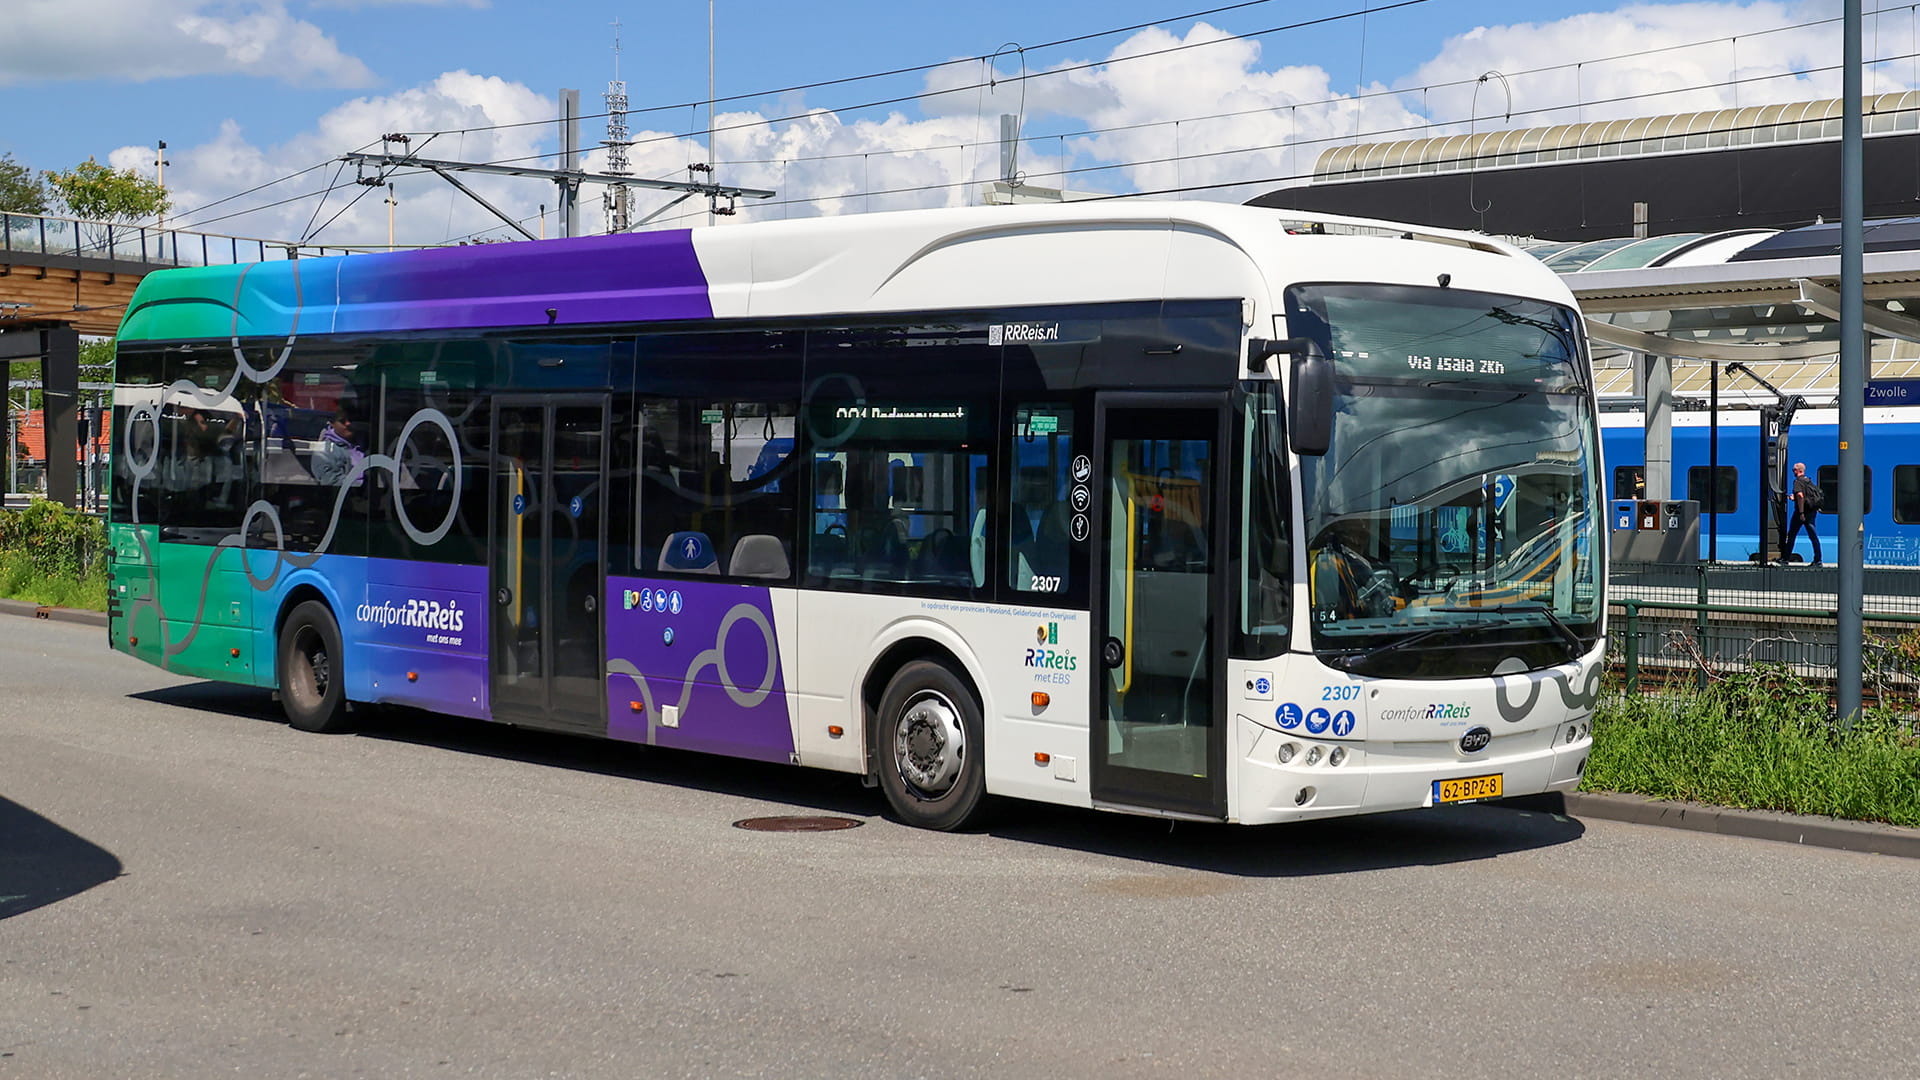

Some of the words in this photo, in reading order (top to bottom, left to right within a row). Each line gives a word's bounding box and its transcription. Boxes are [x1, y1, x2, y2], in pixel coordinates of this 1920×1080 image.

[1004, 322, 1059, 341] RRReis.nl
[1869, 386, 1908, 398] Zwolle
[1031, 575, 1061, 592] 2307
[356, 599, 464, 631] comfortRRReis
[1012, 608, 1042, 618] Gelderland
[1025, 648, 1077, 671] RRReis
[1034, 673, 1051, 684] met
[1052, 673, 1071, 685] EBS
[1322, 685, 1361, 701] 2307
[1380, 701, 1471, 722] comfortRRReis
[1463, 733, 1489, 747] BYD
[1443, 778, 1497, 799] 62-BPZ-8
